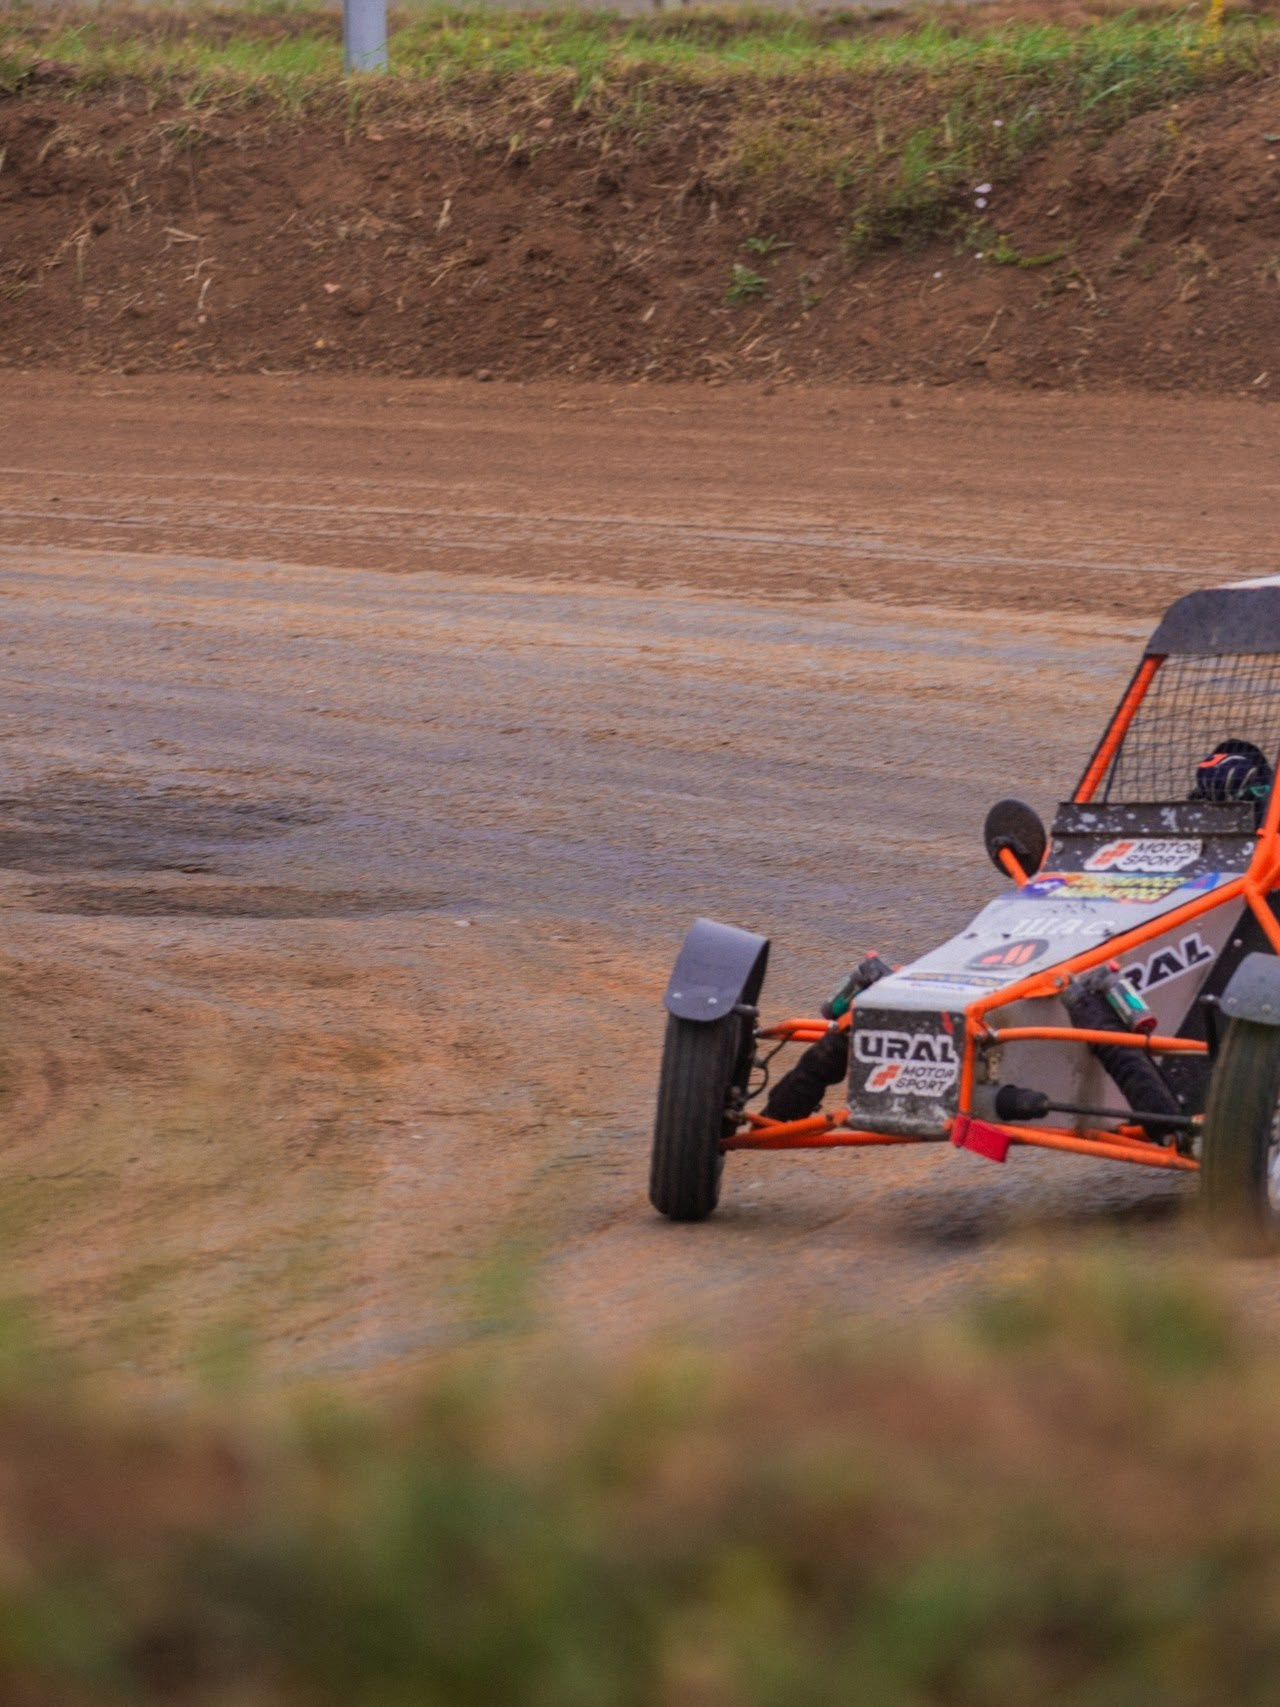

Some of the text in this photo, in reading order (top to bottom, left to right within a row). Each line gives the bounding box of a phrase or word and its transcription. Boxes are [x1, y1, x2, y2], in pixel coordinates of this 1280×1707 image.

[1135, 842, 1200, 854] MOTOR
[1122, 854, 1190, 866] SPORT
[1123, 938, 1212, 992] RAL
[861, 1035, 955, 1063] URAL
[902, 1065, 955, 1079] MOTOR
[895, 1078, 947, 1092] SPORT
